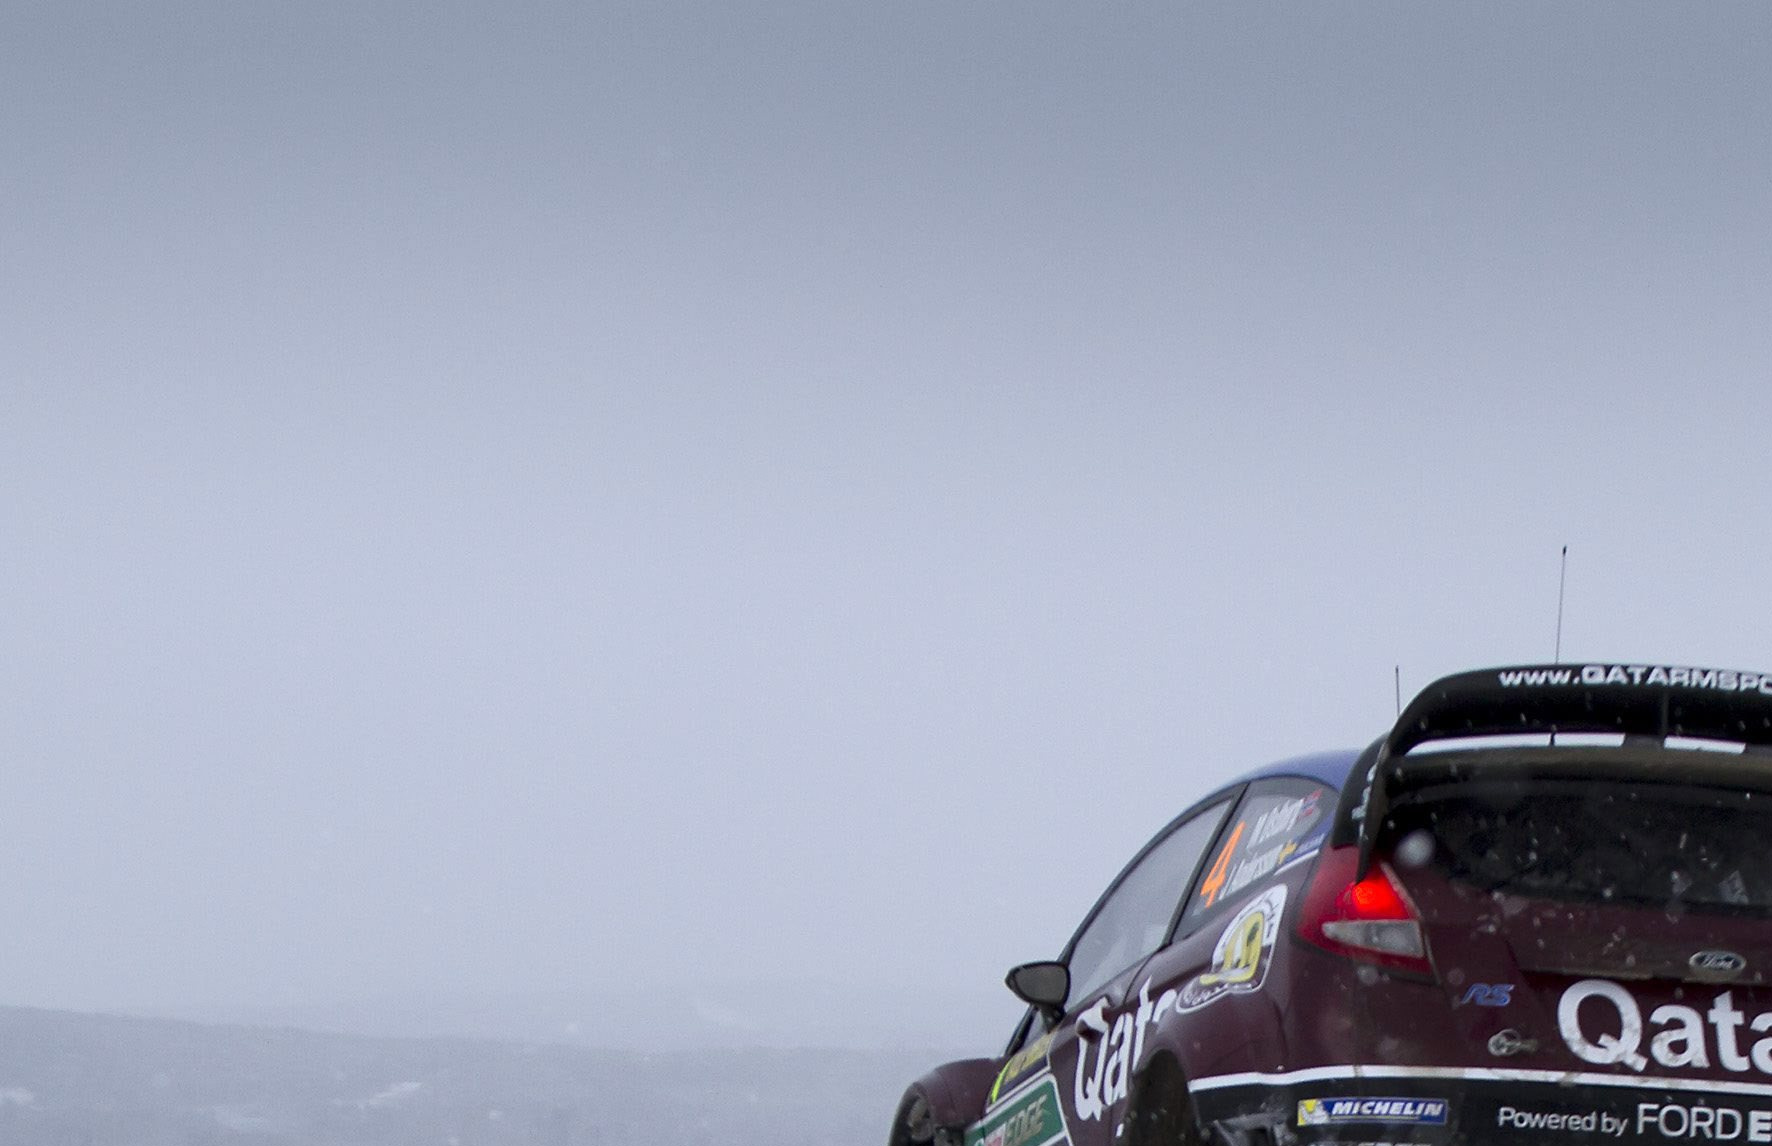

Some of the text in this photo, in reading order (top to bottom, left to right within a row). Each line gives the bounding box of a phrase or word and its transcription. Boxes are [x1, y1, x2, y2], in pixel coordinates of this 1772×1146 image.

[1200, 821, 1247, 909] 4
[1331, 1100, 1444, 1117] MICHELIN
[1498, 1106, 1598, 1132] Powered
[1600, 1111, 1629, 1137] by
[1637, 1103, 1743, 1140] FORD
